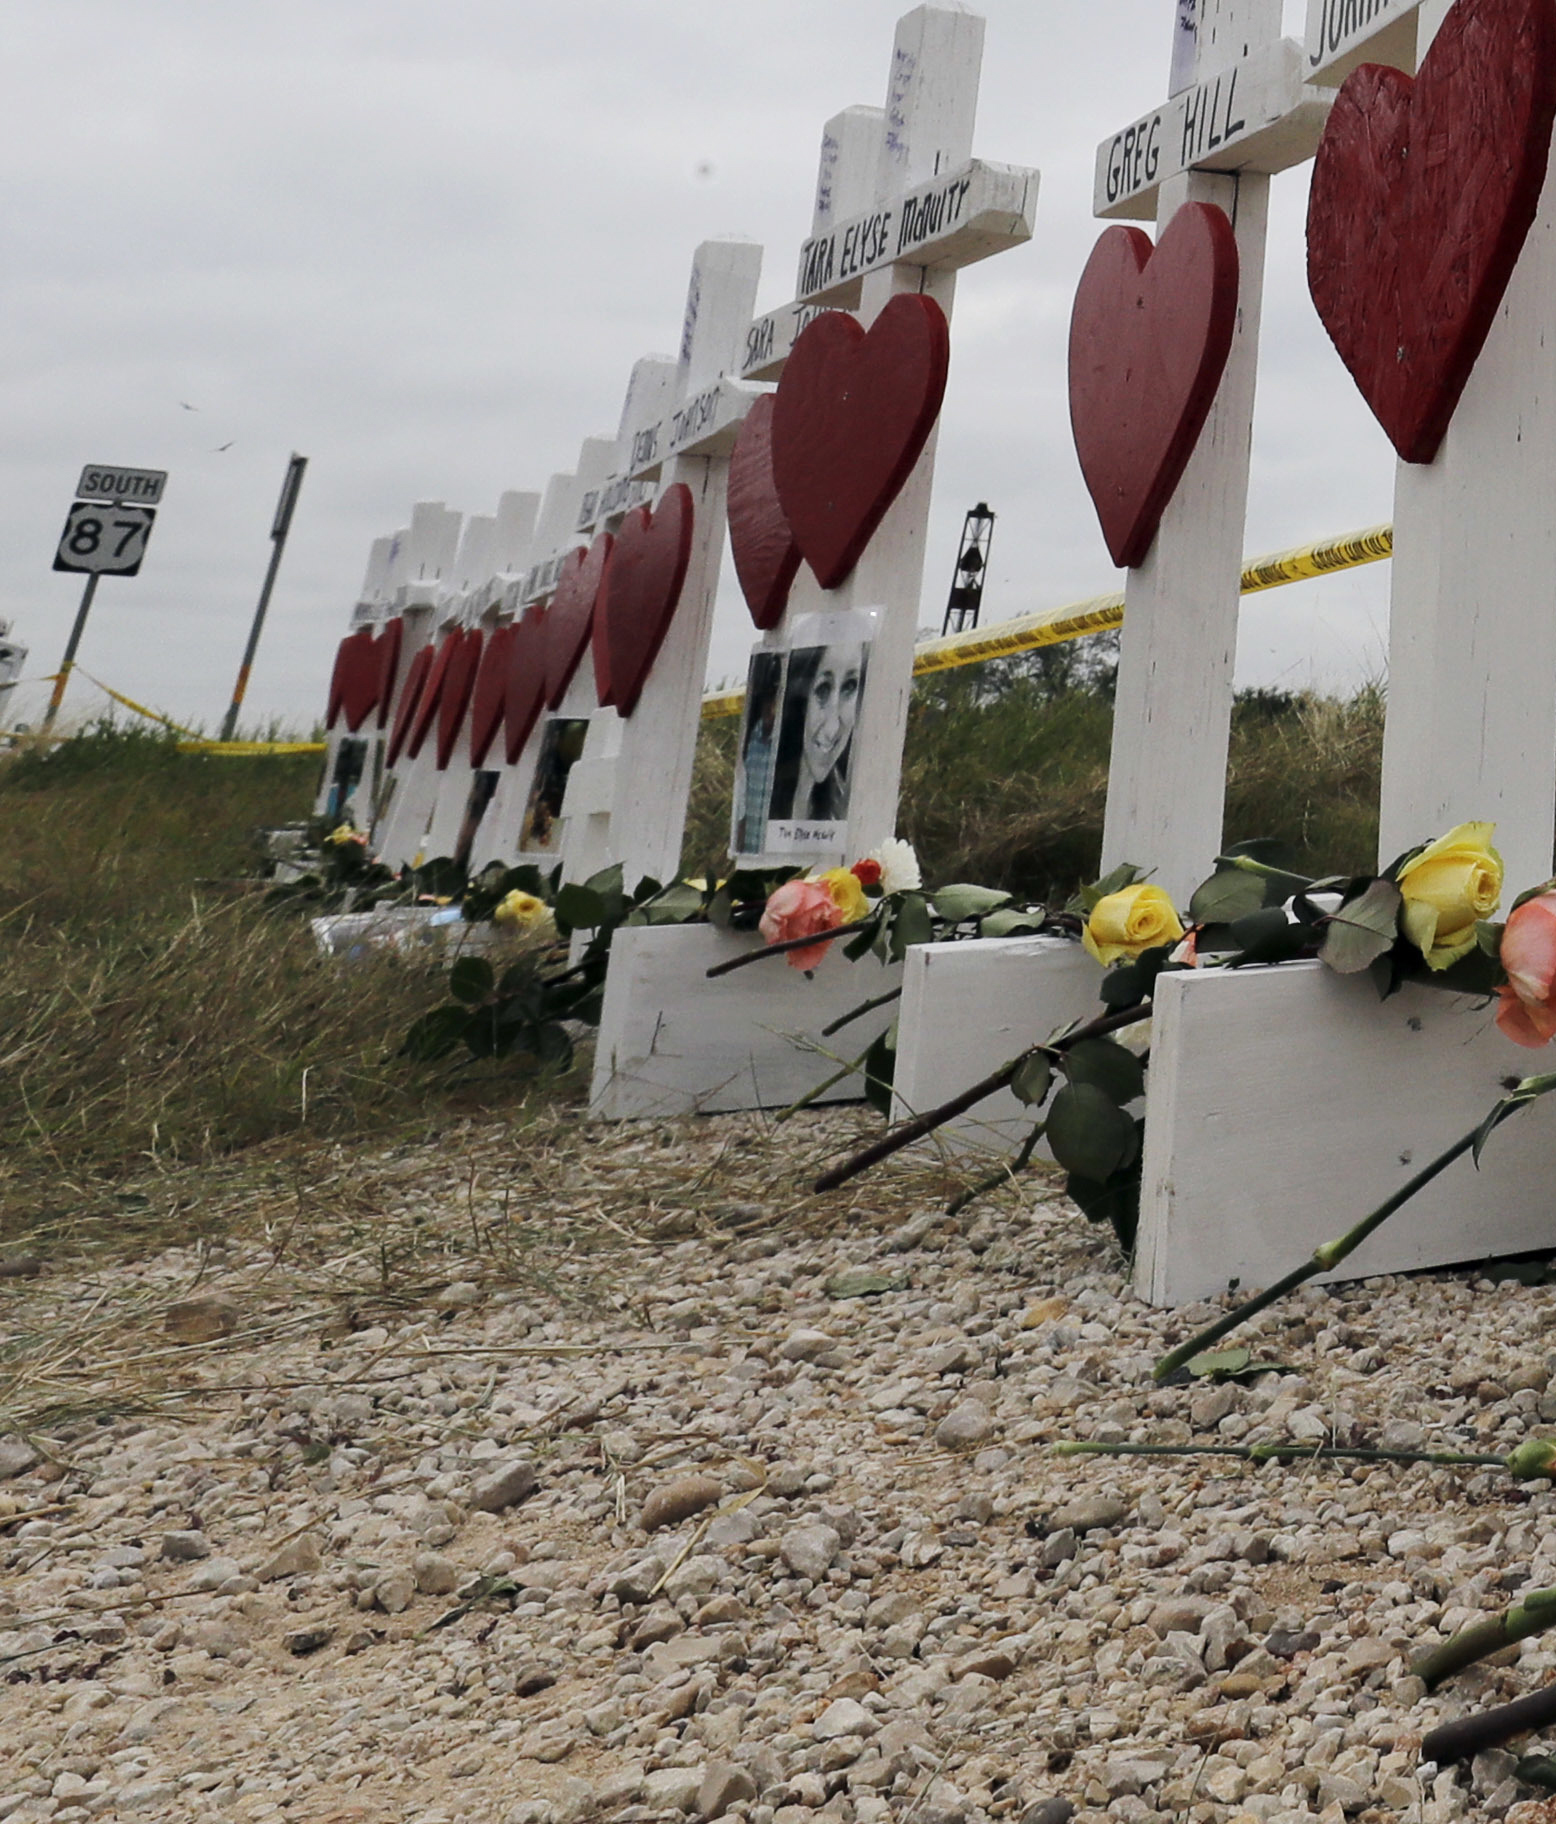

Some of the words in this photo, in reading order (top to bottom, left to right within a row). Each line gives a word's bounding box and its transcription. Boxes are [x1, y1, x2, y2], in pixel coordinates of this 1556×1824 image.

[1106, 116, 1161, 203] GREG
[1179, 68, 1246, 168] HILL
[801, 234, 835, 295] TARA
[840, 212, 892, 278] ELYSE
[84, 472, 159, 497] SOUTH
[69, 517, 143, 557] 87
